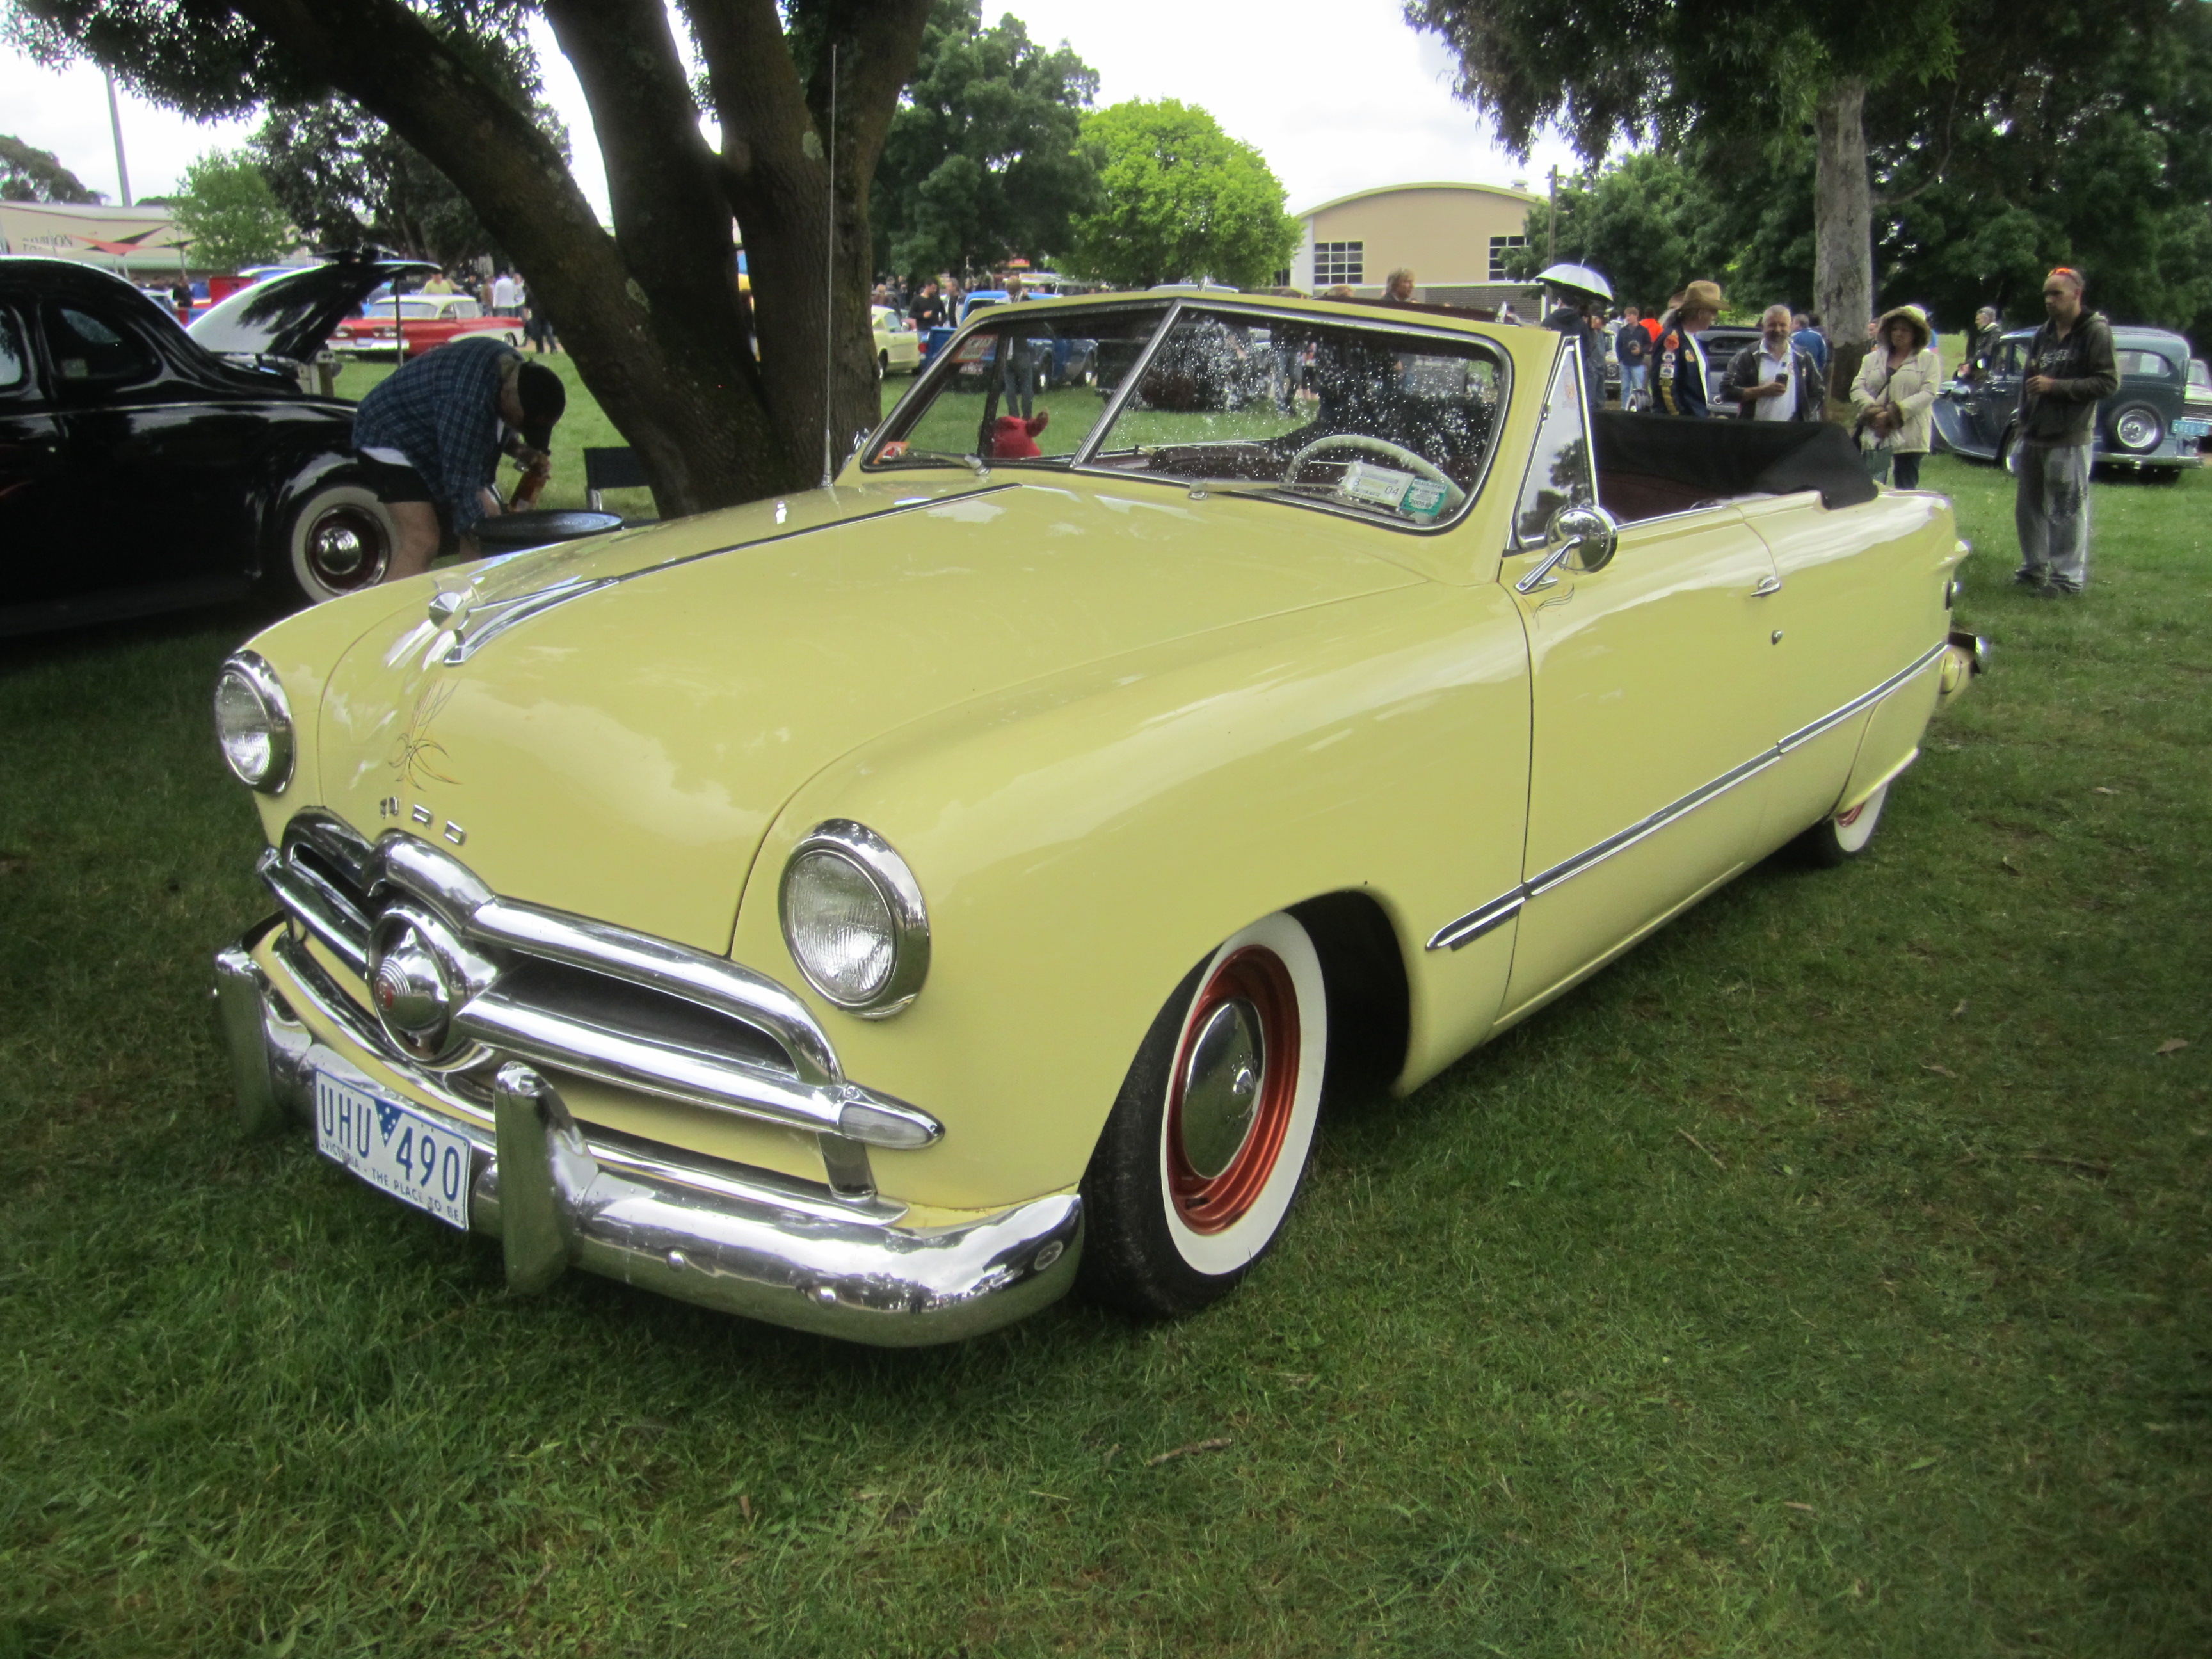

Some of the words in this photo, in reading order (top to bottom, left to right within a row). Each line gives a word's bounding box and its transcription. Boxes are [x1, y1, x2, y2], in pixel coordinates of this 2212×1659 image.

[1384, 485, 1399, 496] 04
[321, 1084, 371, 1159] UHU
[396, 1126, 460, 1202] 490
[371, 1167, 389, 1185] THE
[394, 1179, 424, 1203] PLACE
[447, 1206, 460, 1221] BE
